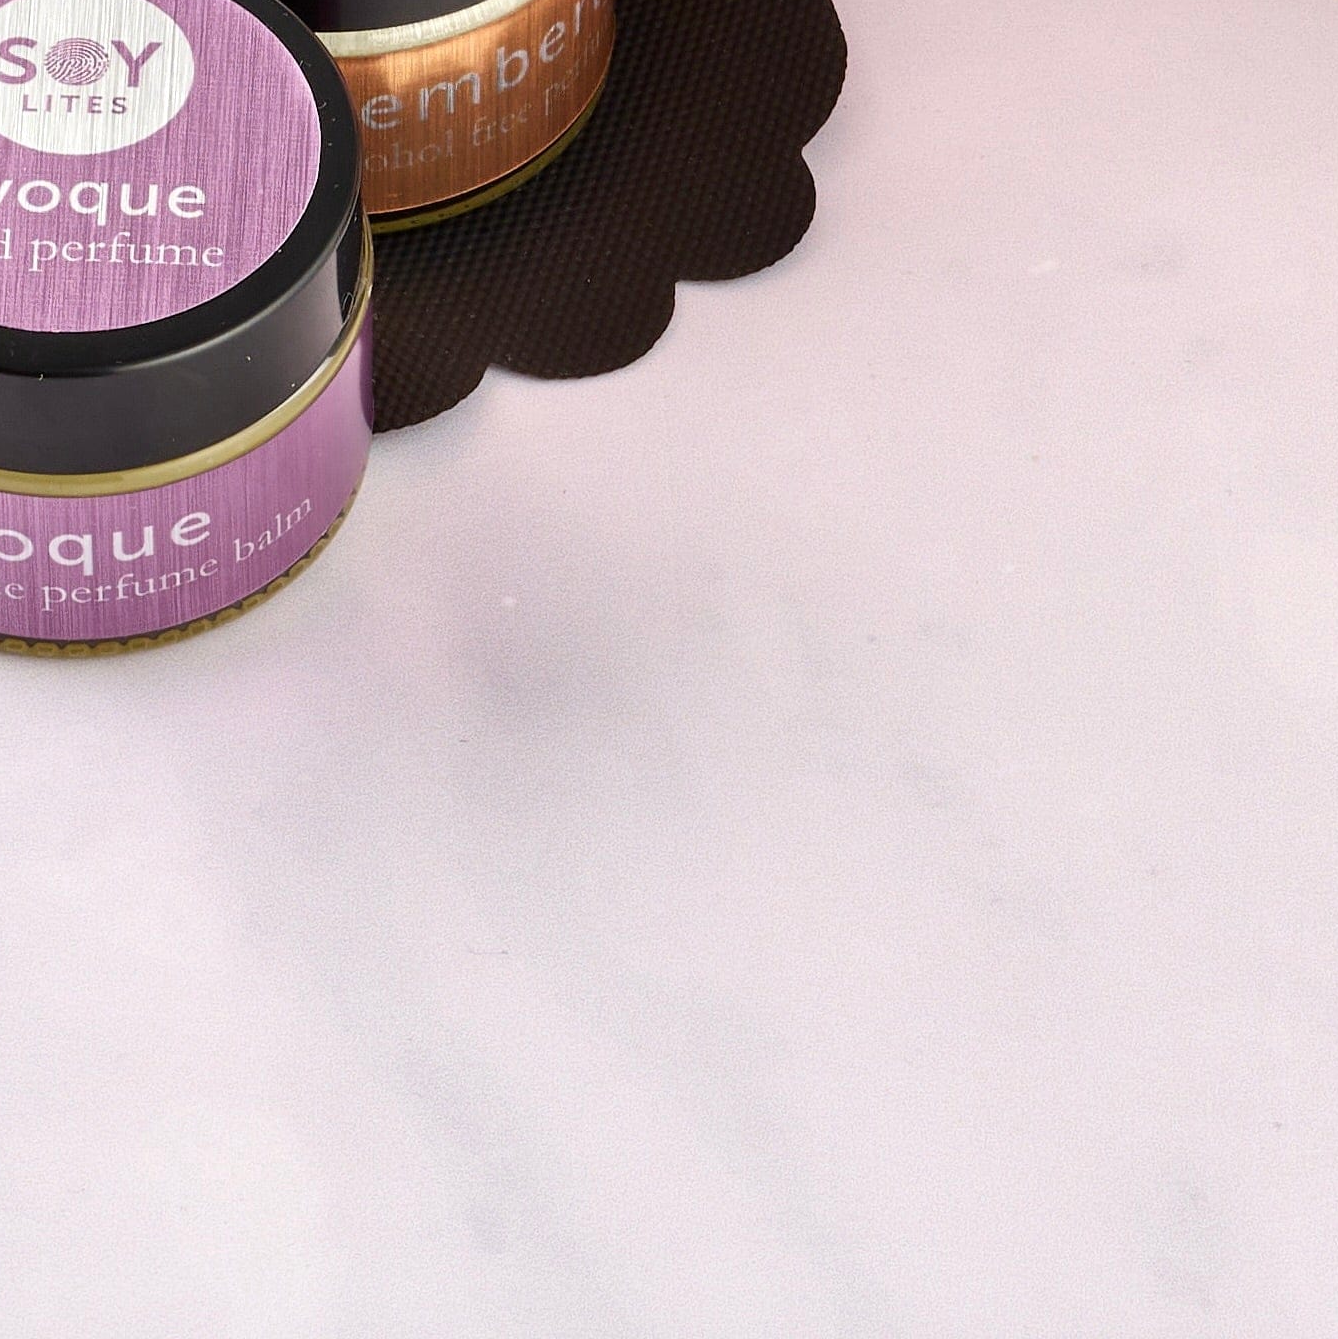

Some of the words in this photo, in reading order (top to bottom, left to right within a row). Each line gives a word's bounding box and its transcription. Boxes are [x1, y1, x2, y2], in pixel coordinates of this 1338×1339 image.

[22, 94, 130, 115] LITES
[364, 128, 454, 173] ohol
[28, 231, 225, 272] perfume
[41, 556, 219, 612] perfume
[232, 496, 314, 566] balm
